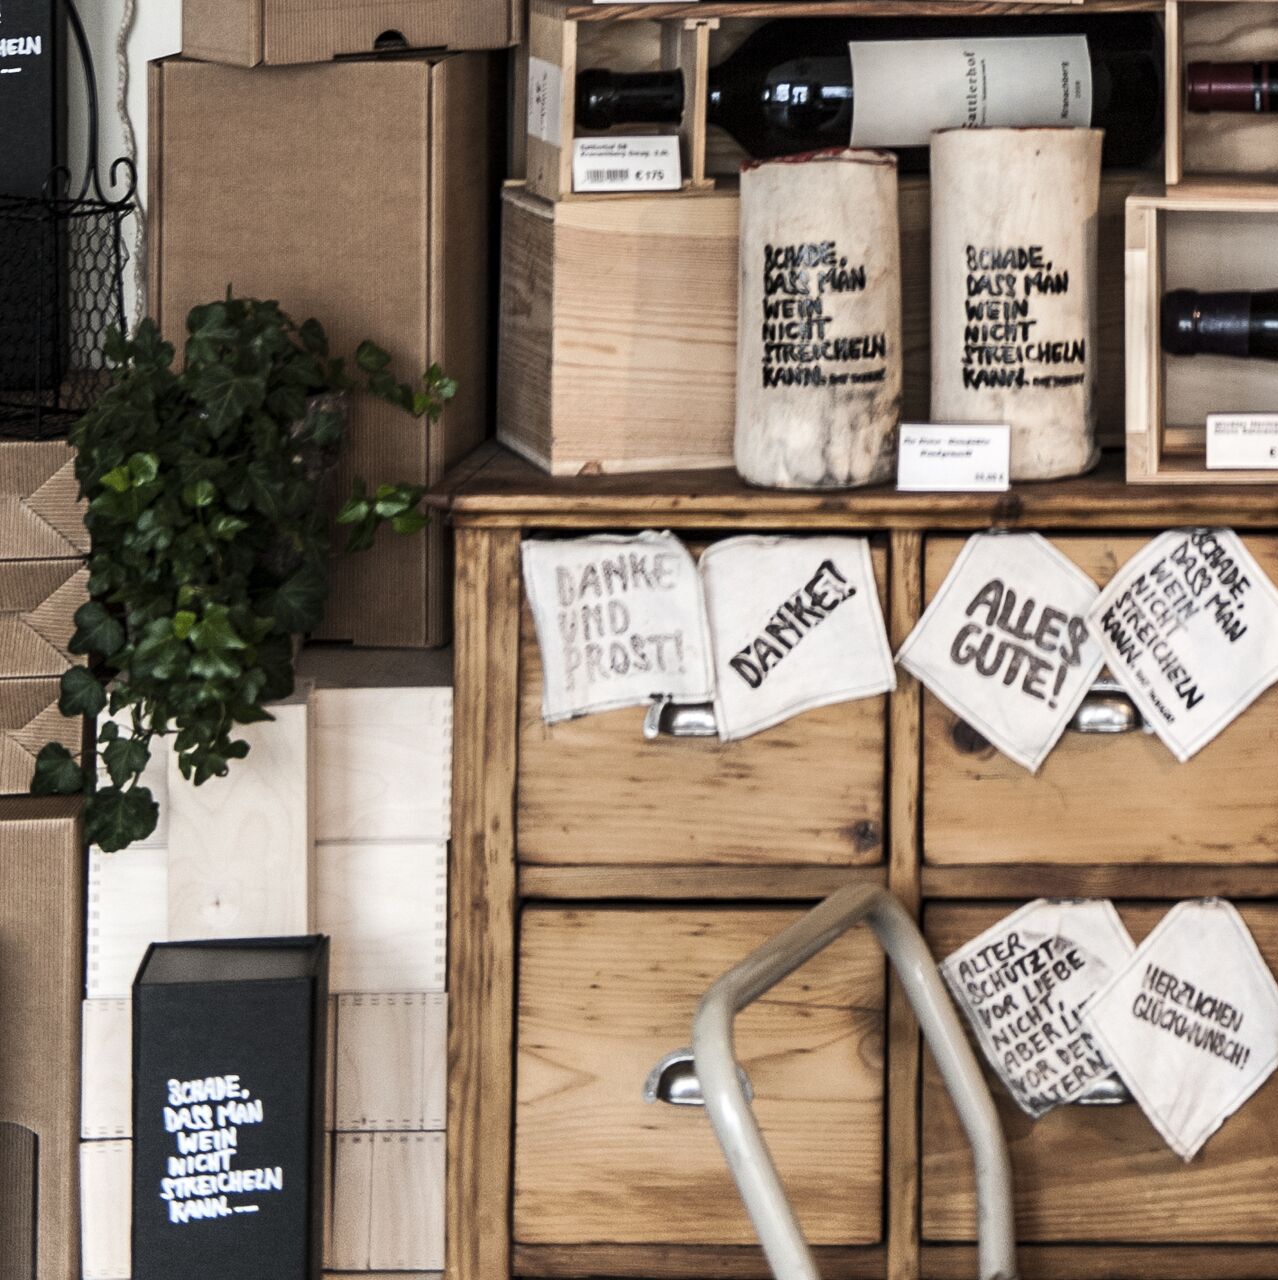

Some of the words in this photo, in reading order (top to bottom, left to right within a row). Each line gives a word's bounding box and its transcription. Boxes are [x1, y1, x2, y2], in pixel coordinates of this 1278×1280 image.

[818, 266, 866, 293] MAN
[1025, 270, 1070, 295] MAN
[761, 298, 823, 321] WEIN
[964, 299, 1029, 322] WEIN
[761, 317, 833, 341] NICHT
[964, 320, 1037, 342] NICHT
[761, 333, 887, 365] STREICHELN
[961, 340, 1085, 367] STREICHELN
[1130, 573, 1188, 637] NICHT
[1149, 555, 1201, 620] WEIN
[1169, 539, 1213, 597] DASS
[1204, 593, 1248, 645] MAN
[554, 550, 681, 608] DANKE
[729, 558, 857, 690] DANKE!
[557, 597, 631, 643] UND
[965, 576, 1090, 669] ALLES
[949, 622, 1071, 711] GUTE!
[1115, 590, 1204, 712] STREICHELN
[957, 932, 1026, 981] ALTER
[978, 994, 1020, 1030] VOR
[1026, 948, 1087, 1004] LIEBE
[1144, 963, 1245, 1033] HERZLICHEN
[1003, 1025, 1065, 1075] ABER
[1010, 1059, 1058, 1095] VOR
[162, 1103, 214, 1133] DASS
[217, 1099, 264, 1127] MAN
[176, 1125, 238, 1155] WEIN
[167, 1147, 237, 1177] NICHT
[159, 1165, 283, 1201] STREICHELN
